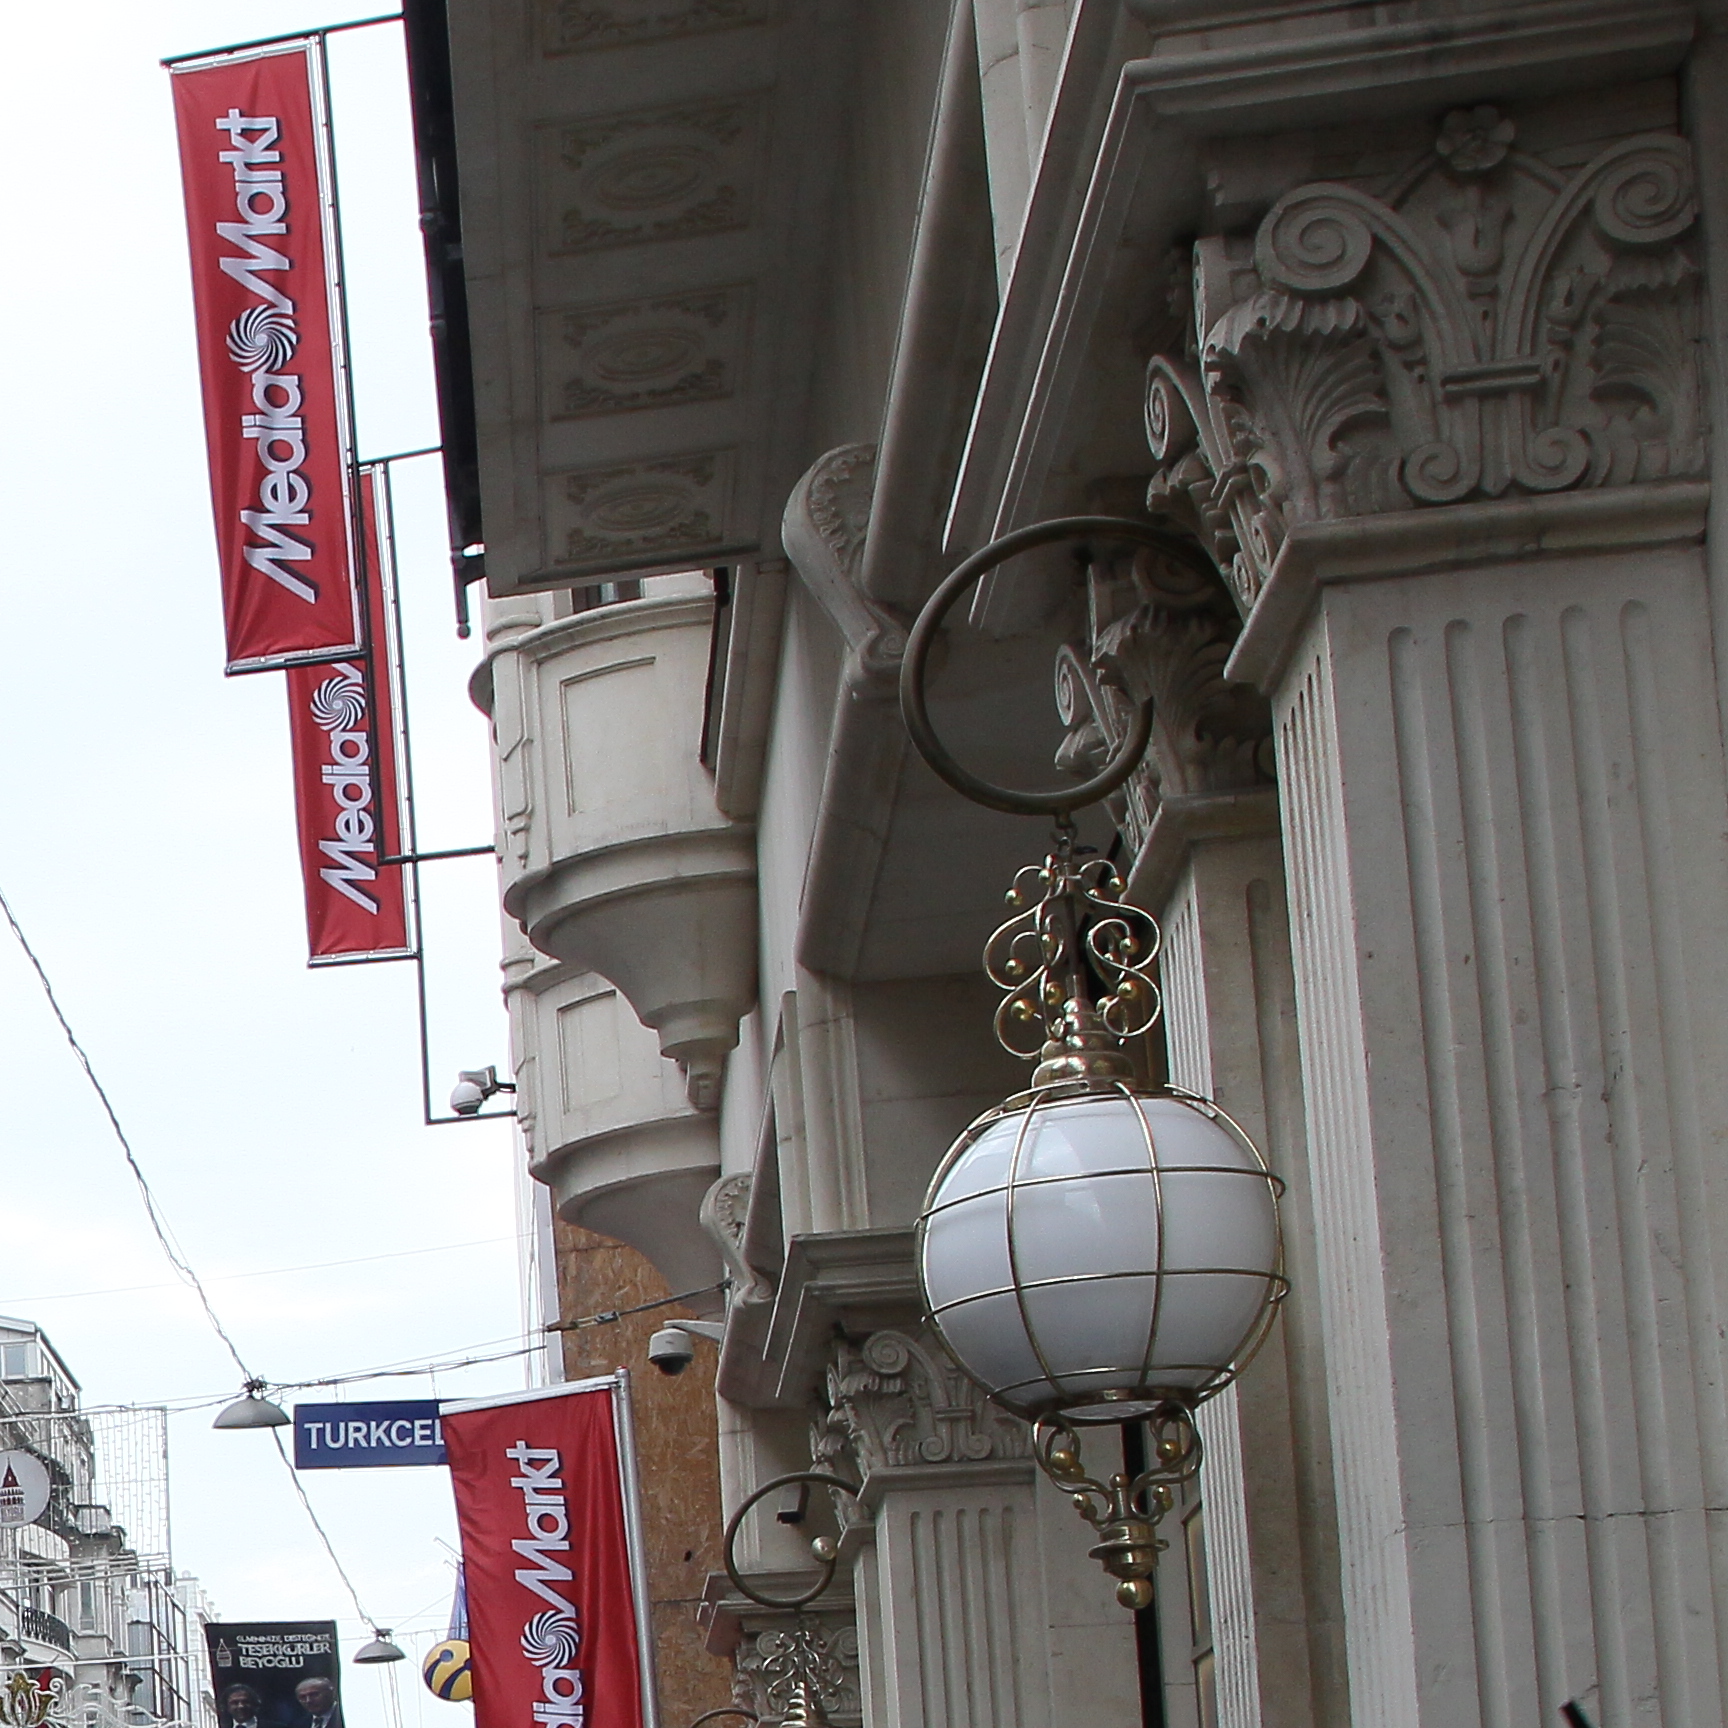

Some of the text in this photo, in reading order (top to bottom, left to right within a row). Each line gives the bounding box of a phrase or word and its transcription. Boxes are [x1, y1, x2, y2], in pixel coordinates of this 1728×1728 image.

[216, 108, 315, 605] Media Markt
[319, 733, 378, 914] Media
[304, 1418, 445, 1449] TURKCEL
[506, 1440, 578, 1622] Markt
